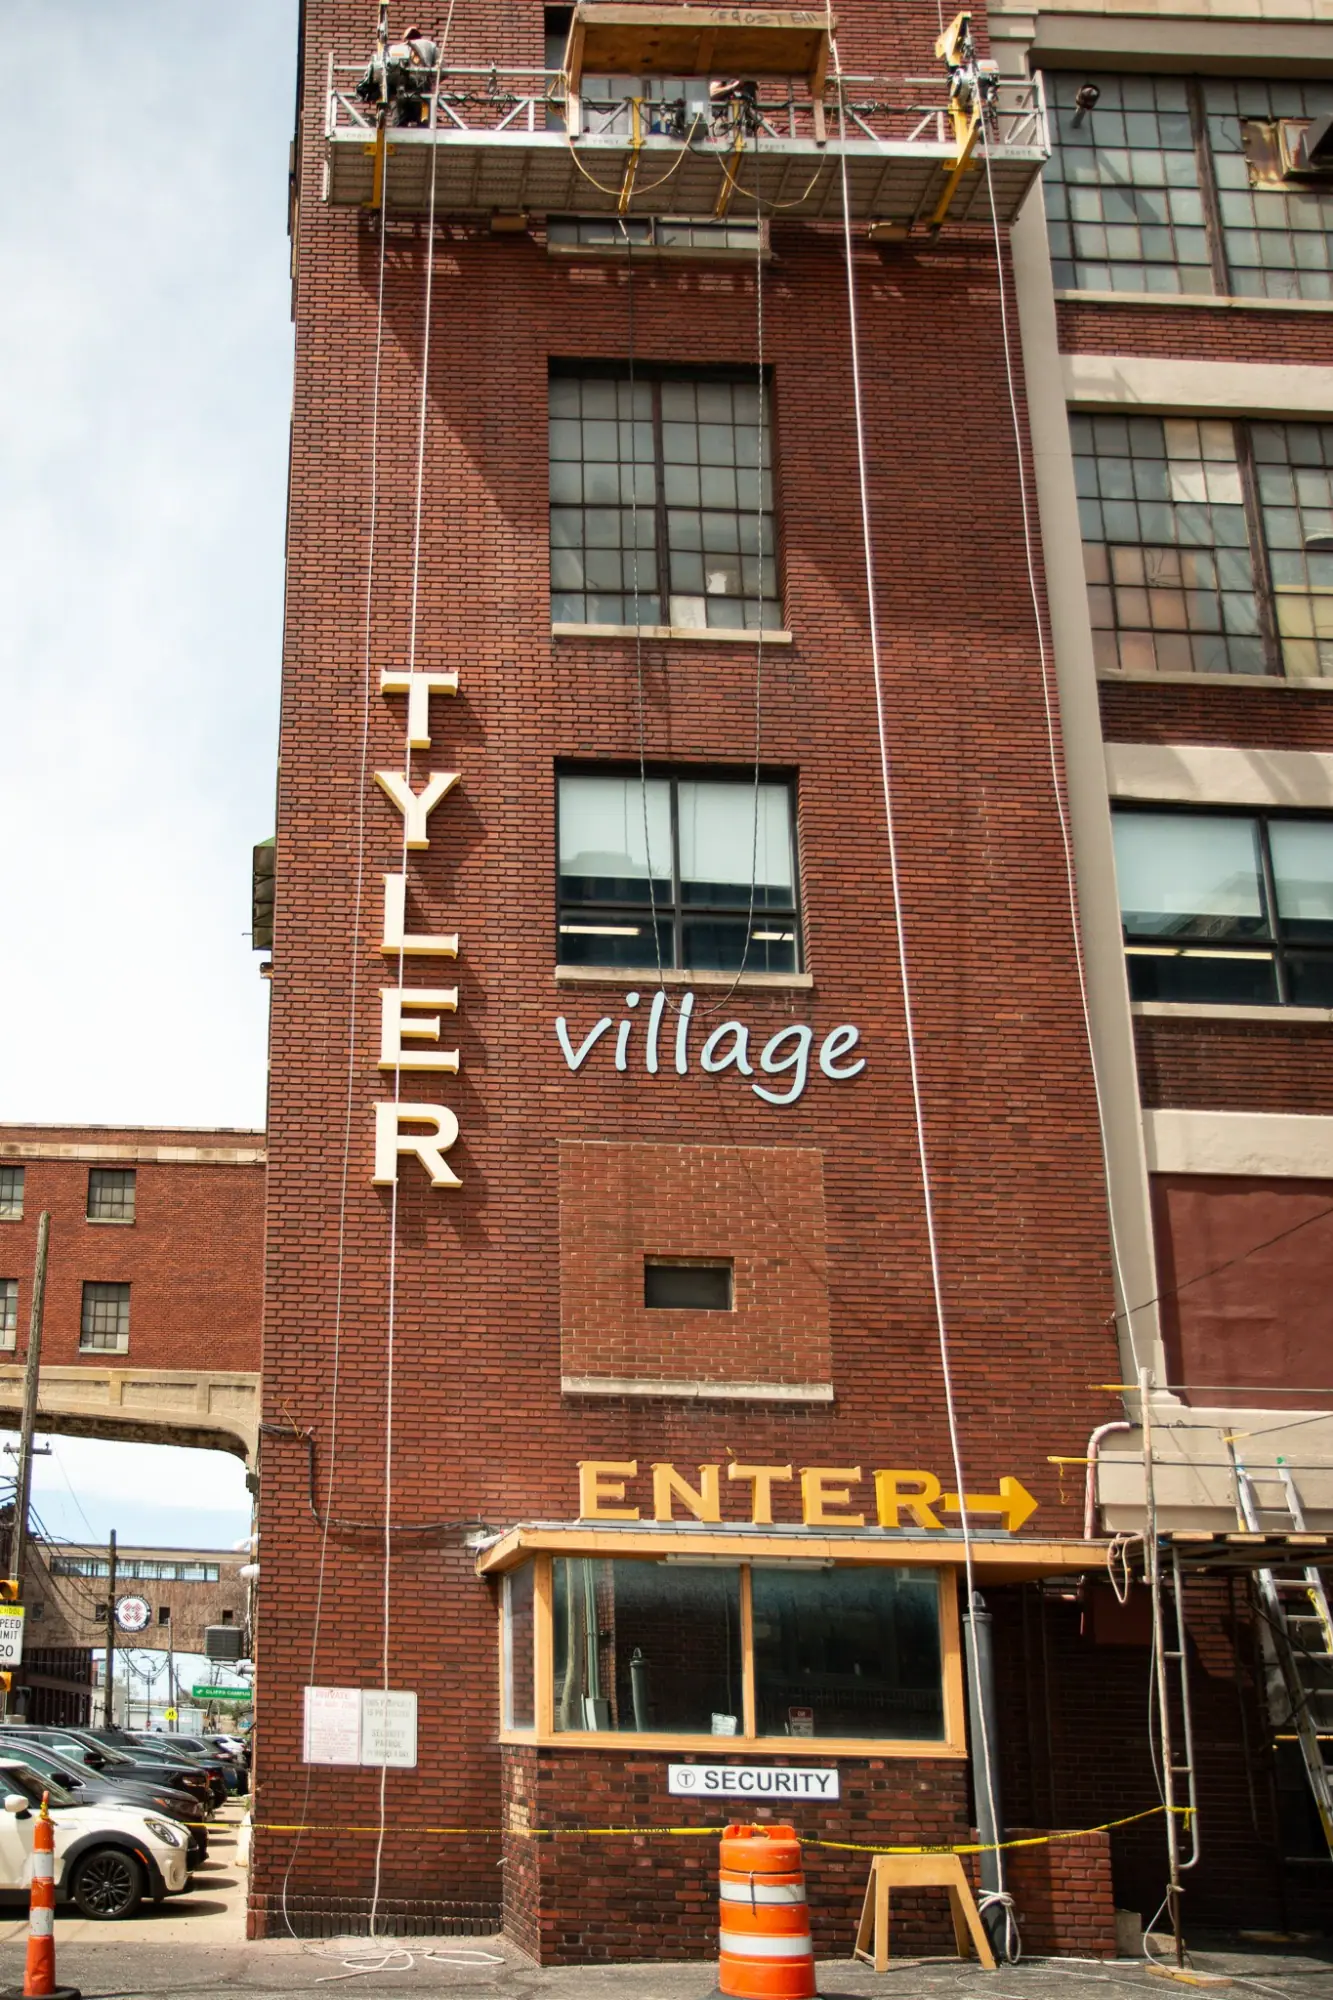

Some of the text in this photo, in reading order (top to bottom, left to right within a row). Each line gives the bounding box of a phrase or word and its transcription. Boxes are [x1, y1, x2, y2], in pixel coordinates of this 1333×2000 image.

[371, 668, 463, 1188] TYLER
[555, 990, 866, 1105] village
[576, 1459, 946, 1530] ENTER
[0, 1618, 21, 1629] PEED
[0, 1630, 18, 1640] IMIT
[704, 1770, 831, 1793] SECURITY
